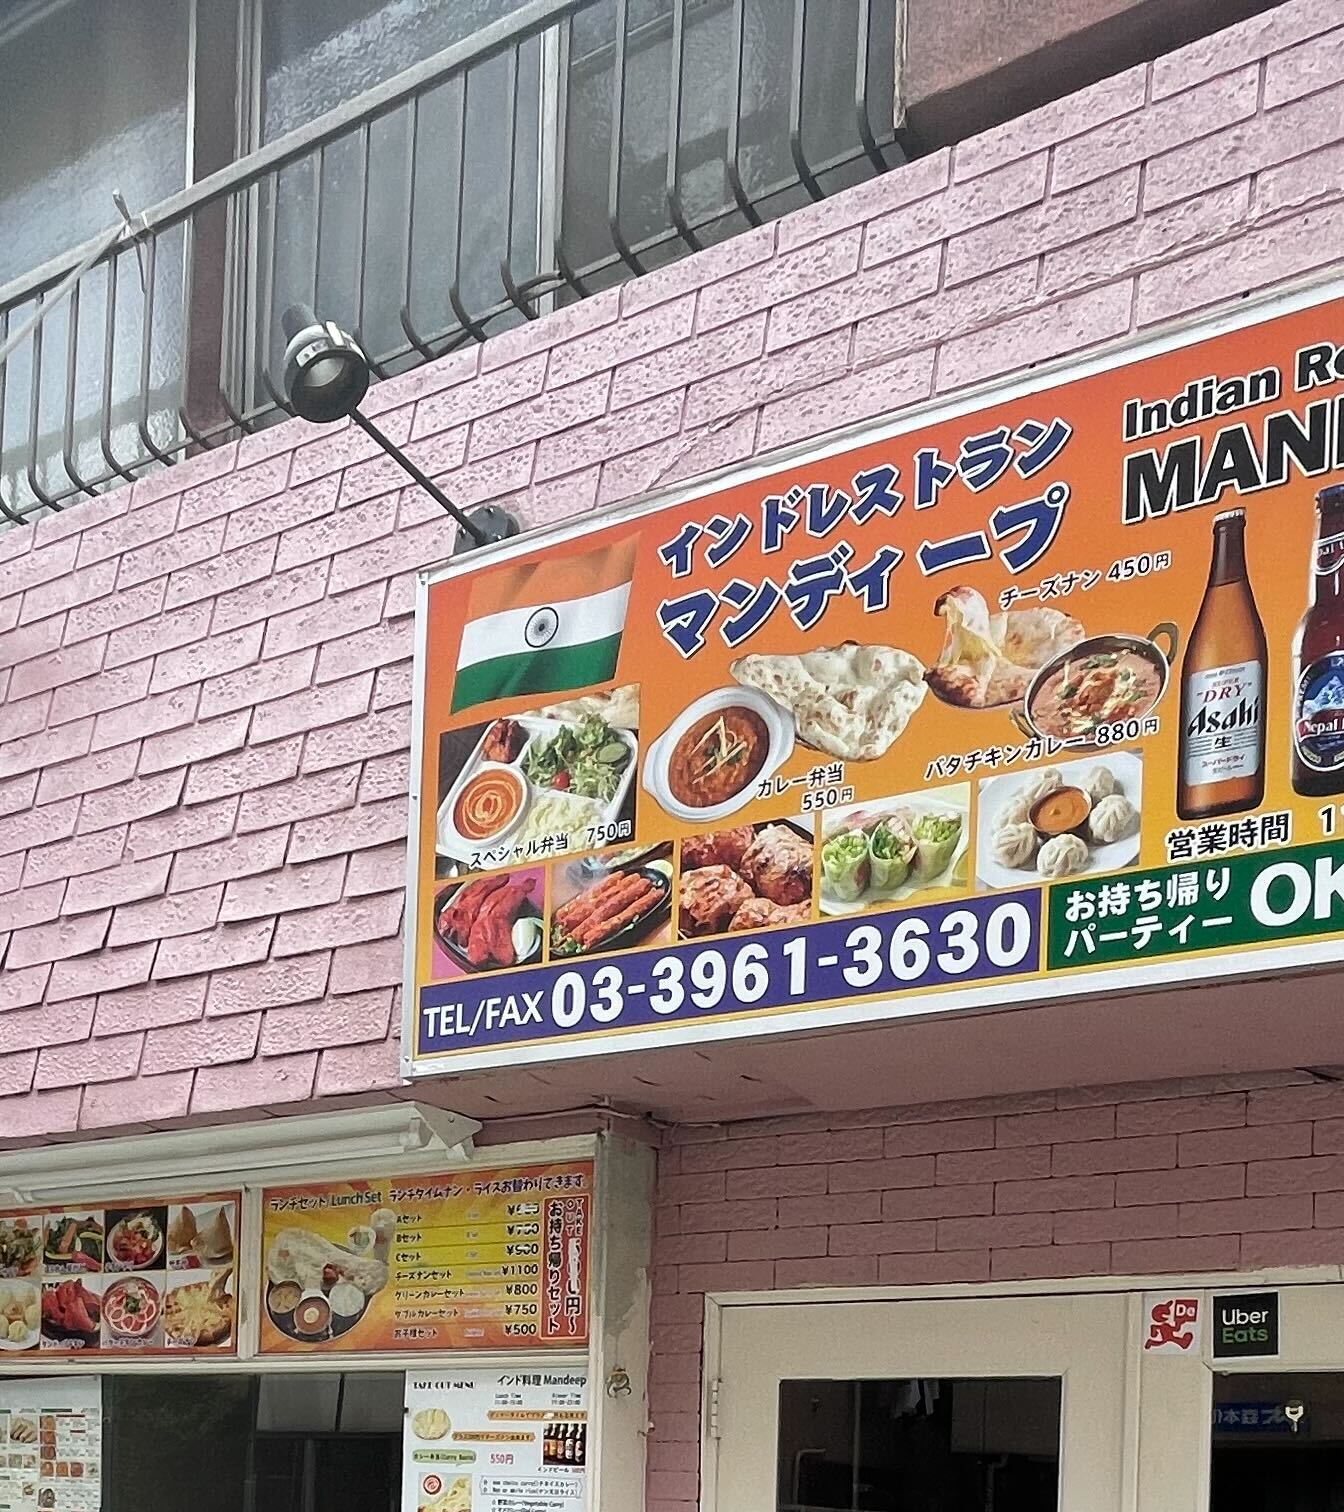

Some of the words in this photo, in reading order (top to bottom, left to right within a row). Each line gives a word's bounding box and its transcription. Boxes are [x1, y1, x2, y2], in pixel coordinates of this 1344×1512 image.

[1124, 366, 1280, 440] Indian
[658, 418, 1073, 578] インドレストラン
[656, 482, 1072, 659] マンディープ
[1000, 570, 1102, 610] チーズナン
[1107, 550, 1172, 583] 450円
[1188, 695, 1259, 737] Asahi
[925, 736, 1092, 780] バタチキンカレー
[1096, 718, 1159, 746] 880円
[1214, 736, 1233, 750] 生
[757, 763, 844, 799] カレー弁当
[802, 787, 855, 812] 550円
[470, 832, 570, 869] スペシャル弁当
[586, 819, 633, 844] 750円
[1166, 811, 1291, 862] 営業時間
[1065, 867, 1232, 923] お持ち帰り
[1063, 914, 1233, 957] パーティー
[424, 990, 546, 1038] TEL/FAX
[551, 900, 1031, 1029] 03-3961-3630
[505, 1303, 537, 1317] ¥750
[506, 1283, 538, 1297] ¥800
[505, 1324, 537, 1337] ¥500
[1222, 1308, 1269, 1326] Uber
[1222, 1326, 1269, 1344] Eats
[543, 1373, 587, 1388] Mandeep
